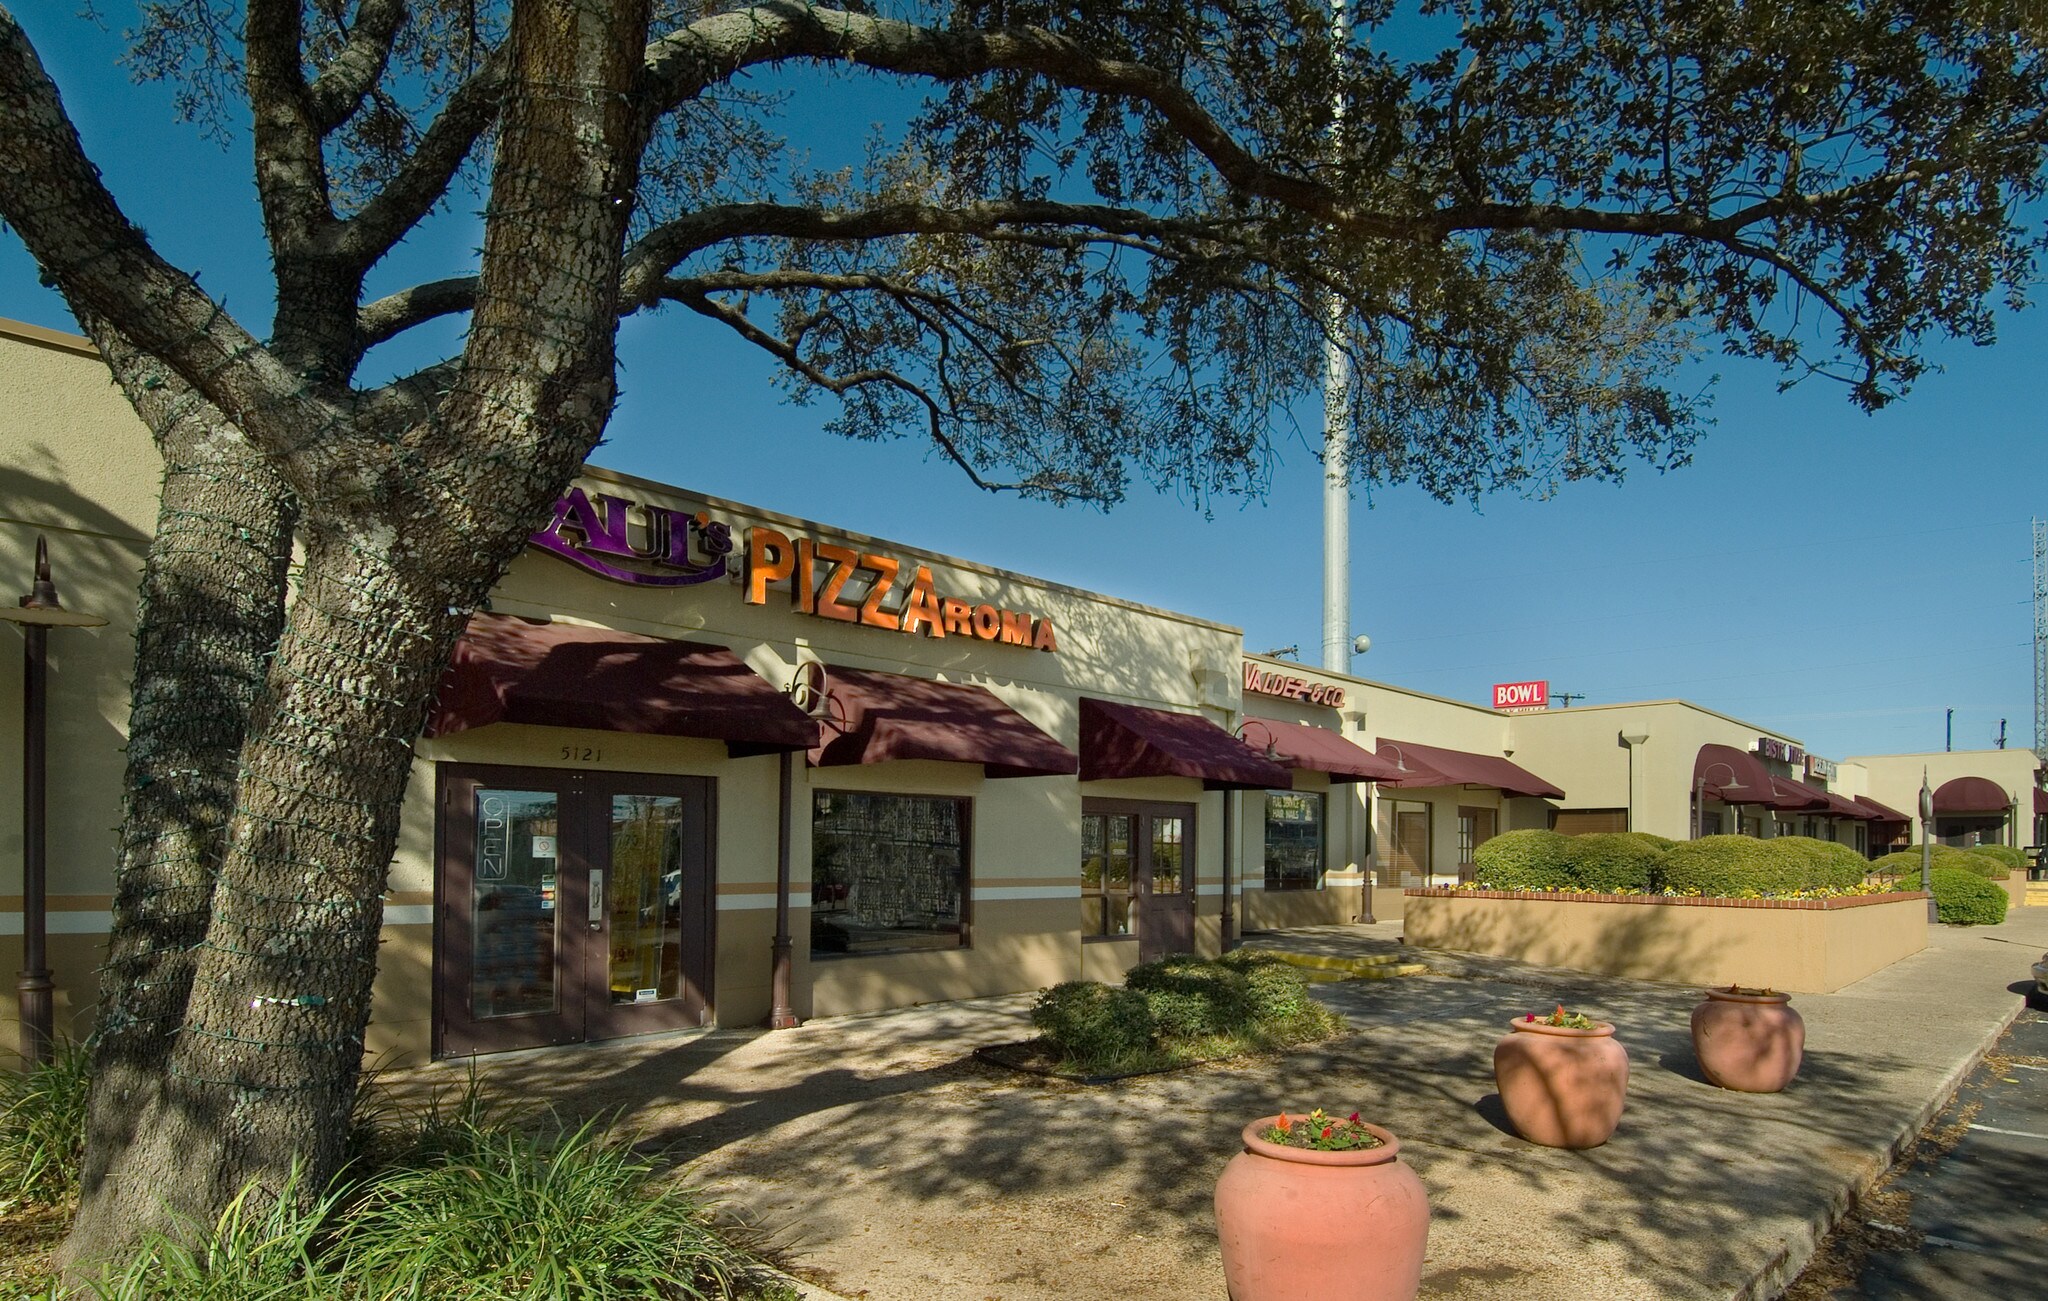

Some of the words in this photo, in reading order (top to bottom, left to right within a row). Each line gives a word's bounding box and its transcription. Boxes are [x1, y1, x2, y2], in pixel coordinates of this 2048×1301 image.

[528, 487, 733, 568] AUL's
[1242, 661, 1312, 699] VALDEZ
[1311, 683, 1324, 702] &
[1497, 684, 1542, 705] BOWL
[561, 746, 601, 762] 5121
[482, 797, 504, 875] OPEN
